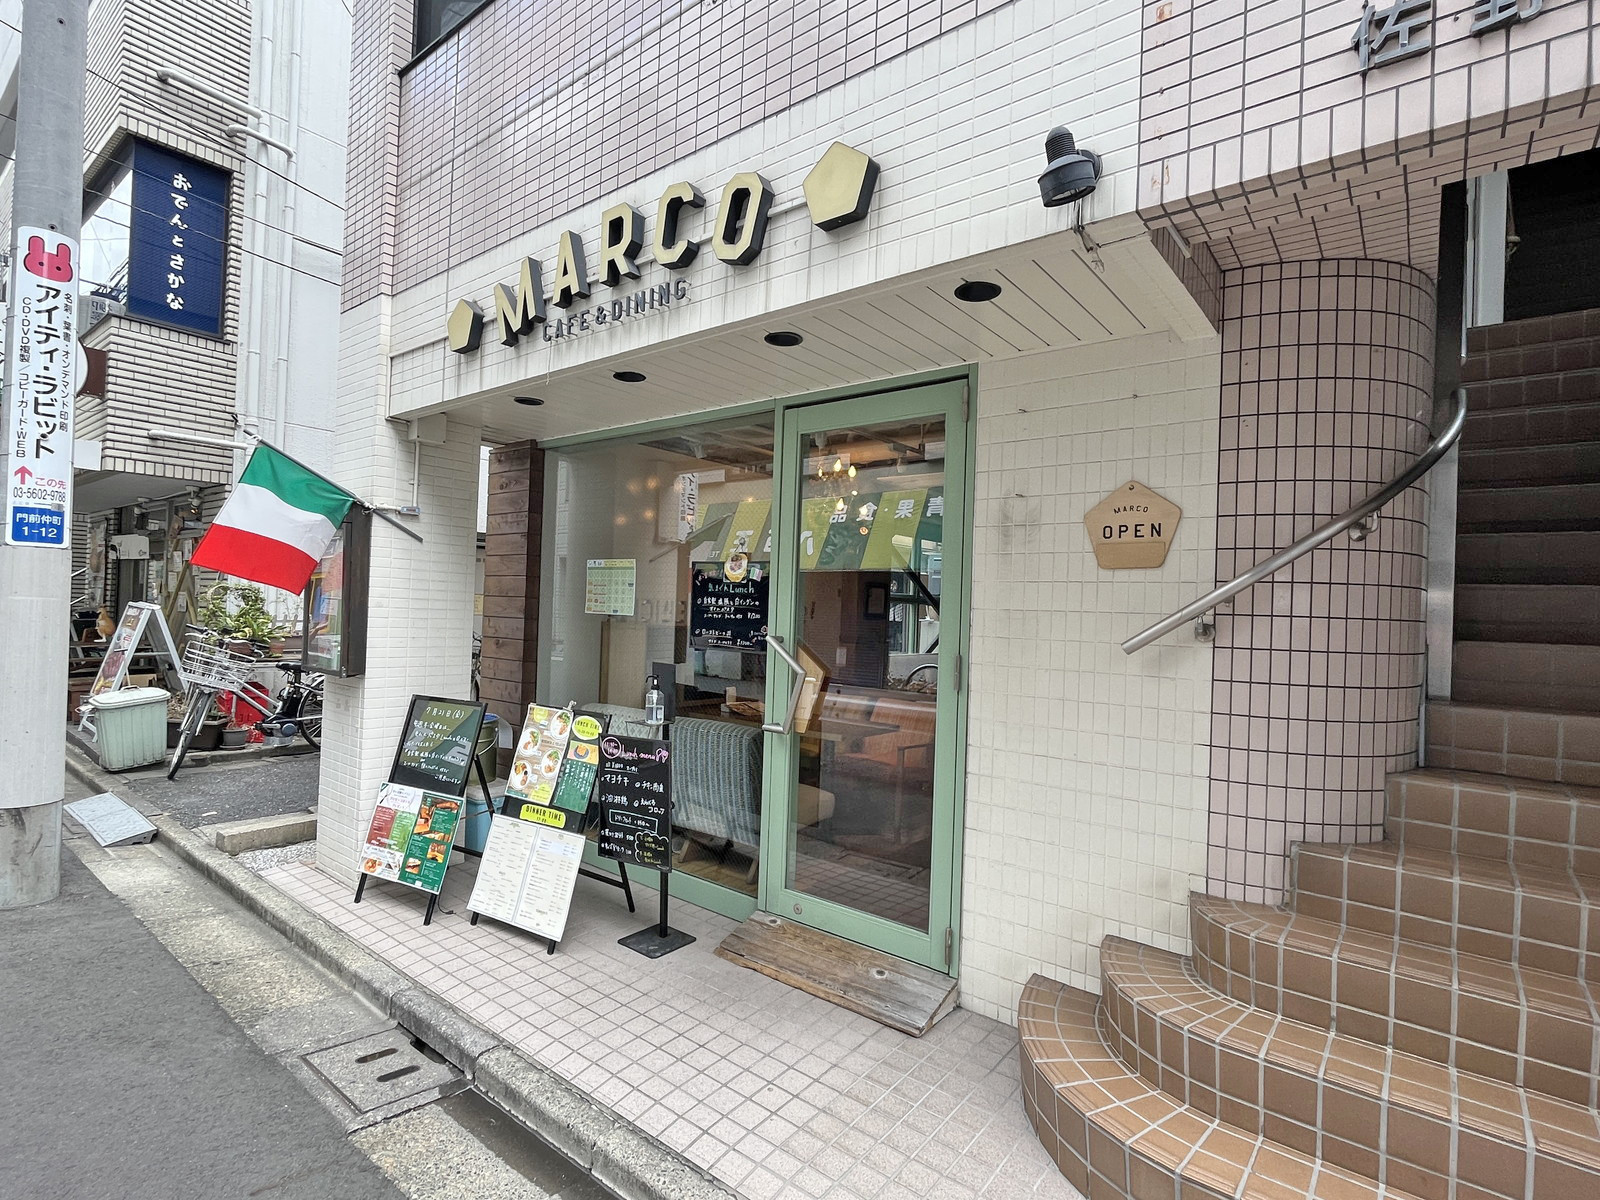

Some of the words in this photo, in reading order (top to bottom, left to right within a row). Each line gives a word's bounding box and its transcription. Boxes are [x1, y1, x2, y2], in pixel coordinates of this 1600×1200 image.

[166, 172, 192, 310] おでんとさかな
[494, 172, 775, 347] MARCO
[32, 284, 62, 459] アイティ・ラビット
[35, 477, 67, 490] この先
[13, 486, 67, 503] 03-5602-9788
[1113, 505, 1149, 514] MARCO
[16, 512, 62, 526] 門前仲町
[22, 526, 57, 538] 1-12
[1102, 523, 1162, 540] OPEN
[525, 805, 547, 816] DINNER
[548, 811, 562, 822] TIME
